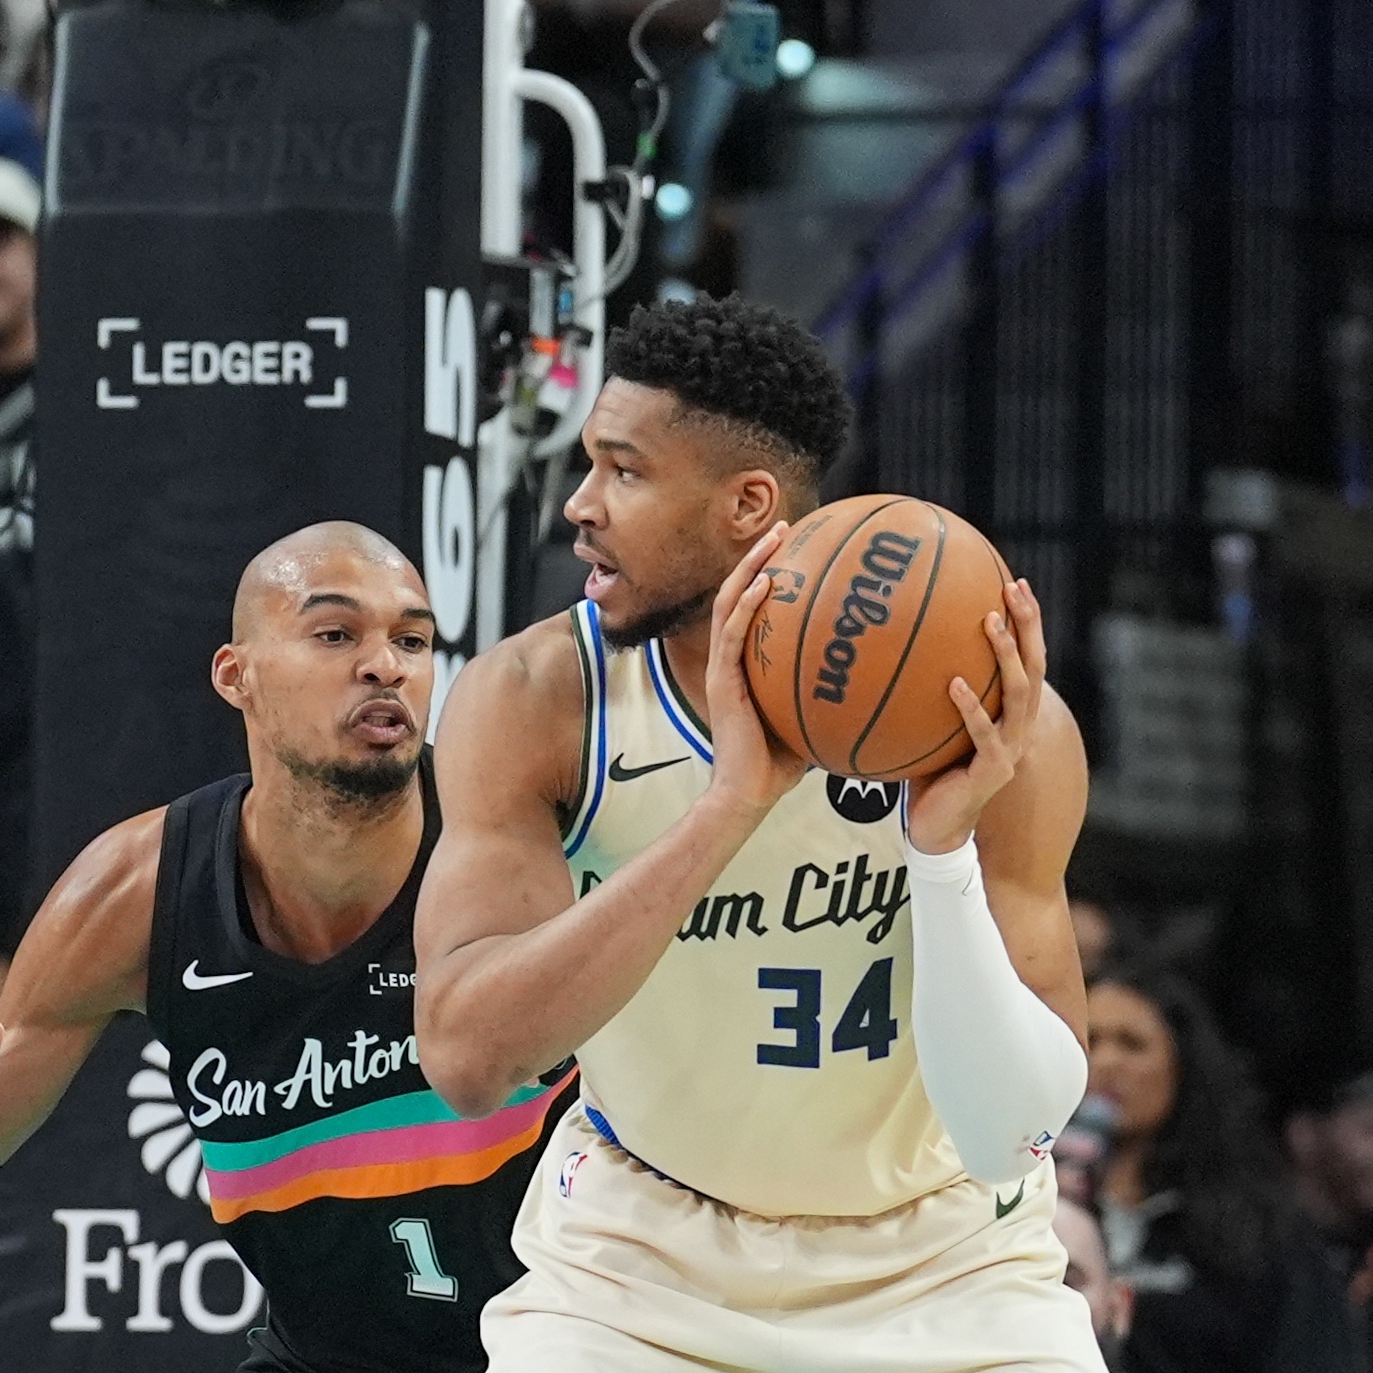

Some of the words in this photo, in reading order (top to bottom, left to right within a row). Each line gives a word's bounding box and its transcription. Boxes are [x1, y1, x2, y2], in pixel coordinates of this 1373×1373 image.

[131, 341, 314, 385] LEDGER
[812, 530, 922, 705] Wilson
[783, 854, 911, 944] City
[757, 957, 898, 1069] 34
[187, 1047, 266, 1127] San
[389, 1218, 458, 1303] 1
